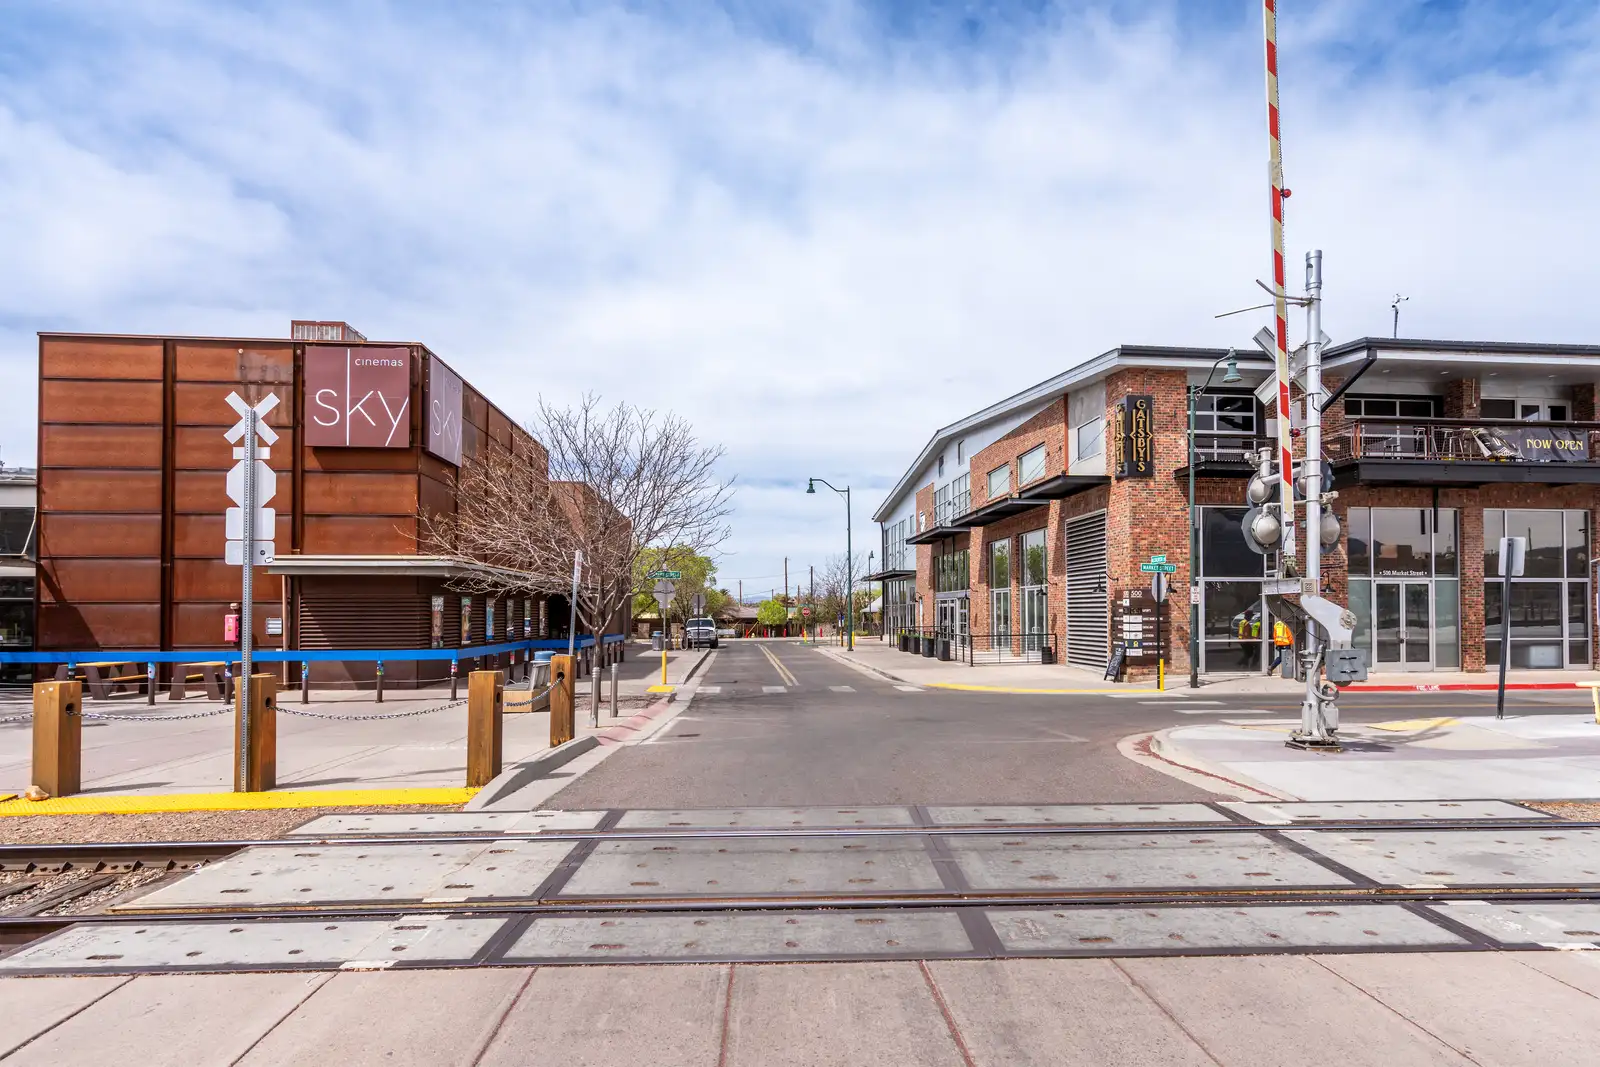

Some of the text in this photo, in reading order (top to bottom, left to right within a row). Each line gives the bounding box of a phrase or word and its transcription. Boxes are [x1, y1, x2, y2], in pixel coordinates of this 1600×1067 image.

[354, 358, 404, 366] cinemas
[1136, 400, 1146, 472] GATSBY'S
[1526, 438, 1584, 450] NOW OPEN
